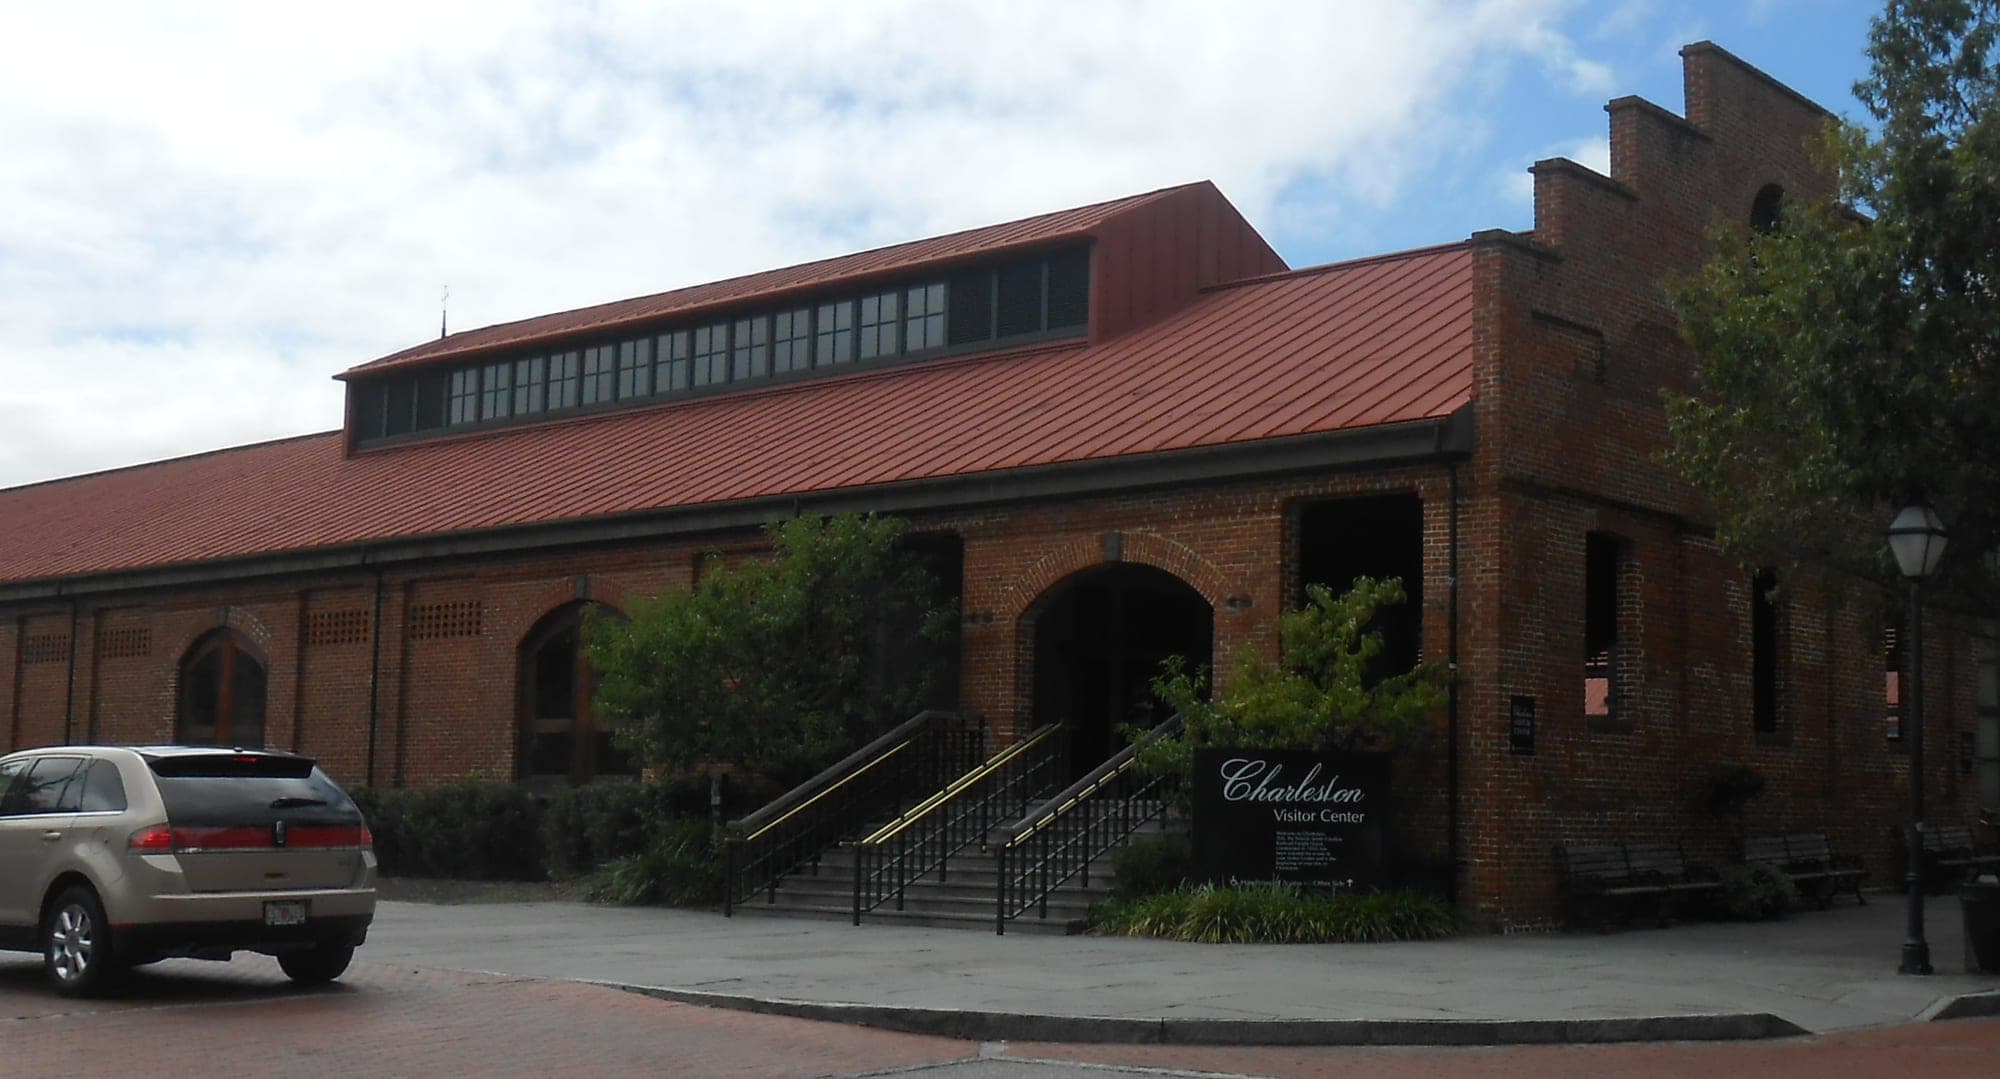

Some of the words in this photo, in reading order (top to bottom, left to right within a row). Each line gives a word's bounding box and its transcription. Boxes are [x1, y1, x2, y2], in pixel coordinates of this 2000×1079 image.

[1221, 758, 1365, 802] Charleston
[1273, 808, 1316, 822] Visitor
[1320, 808, 1365, 823] Center
